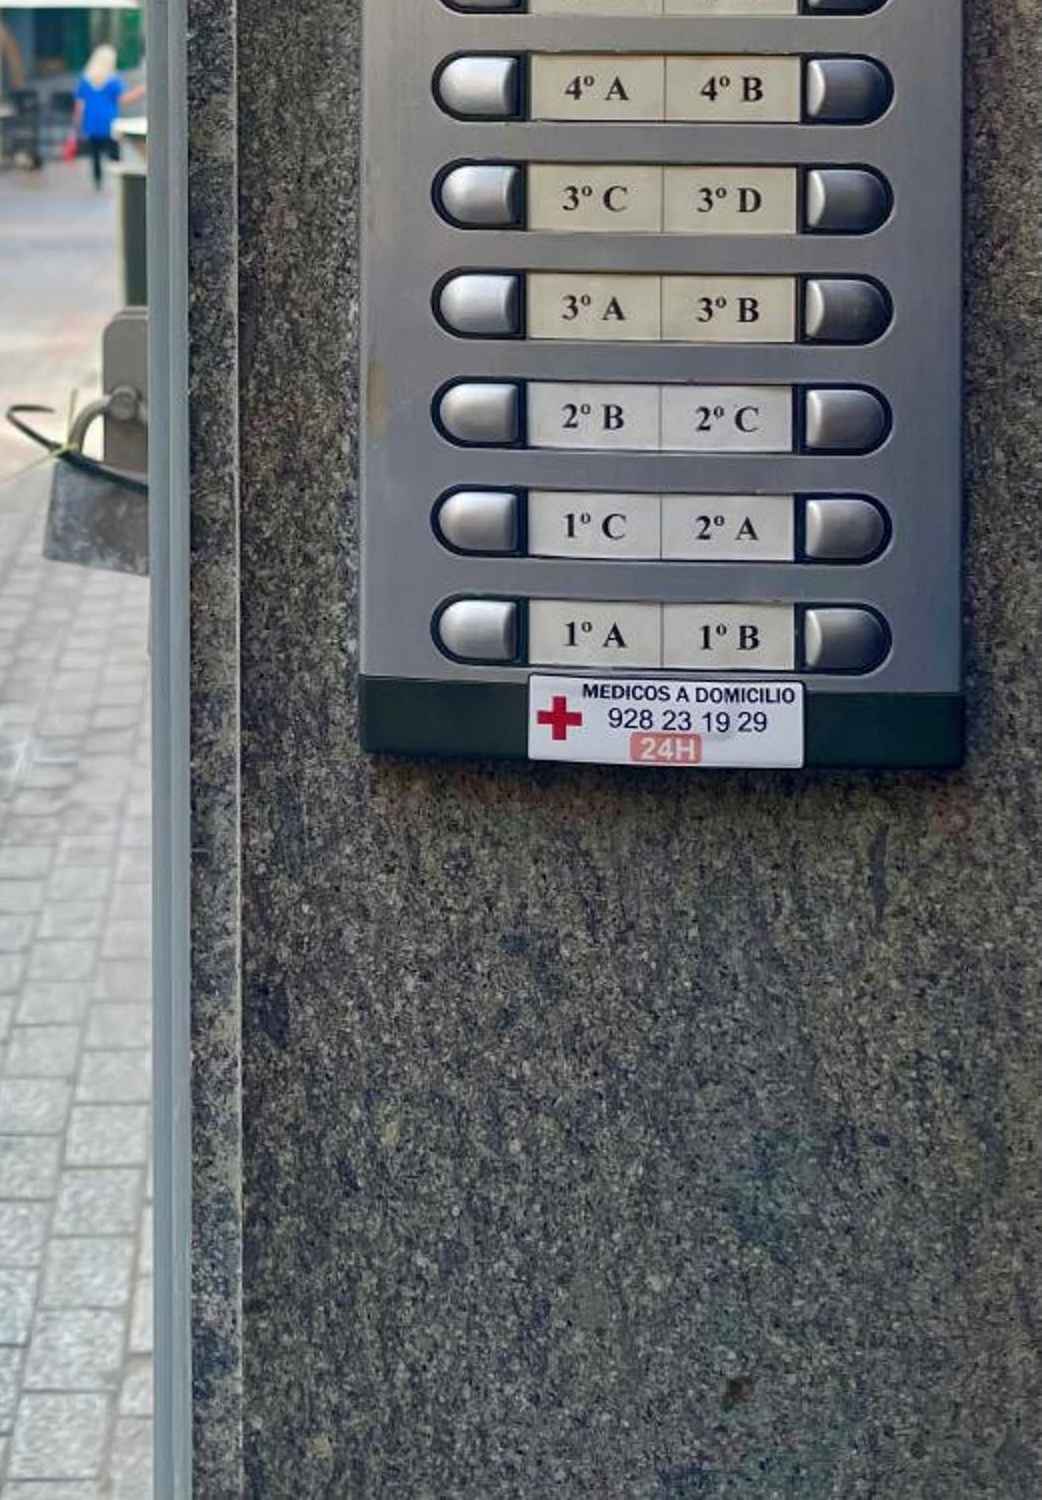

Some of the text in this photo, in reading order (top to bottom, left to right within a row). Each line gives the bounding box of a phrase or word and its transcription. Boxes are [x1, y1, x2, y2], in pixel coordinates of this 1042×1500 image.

[604, 75, 630, 102] A
[742, 76, 764, 103] B
[602, 185, 628, 213] C
[737, 187, 762, 213] D
[601, 296, 626, 322] A
[737, 297, 760, 323] B
[603, 403, 625, 430] B
[734, 405, 760, 433] C
[601, 513, 627, 541] C
[735, 516, 760, 542] A
[602, 622, 627, 649] A
[737, 624, 761, 651] B
[581, 683, 796, 705] MEDICOS A DOMICILIO
[608, 707, 768, 733] 928 23 19 29
[639, 737, 696, 761] 24H
